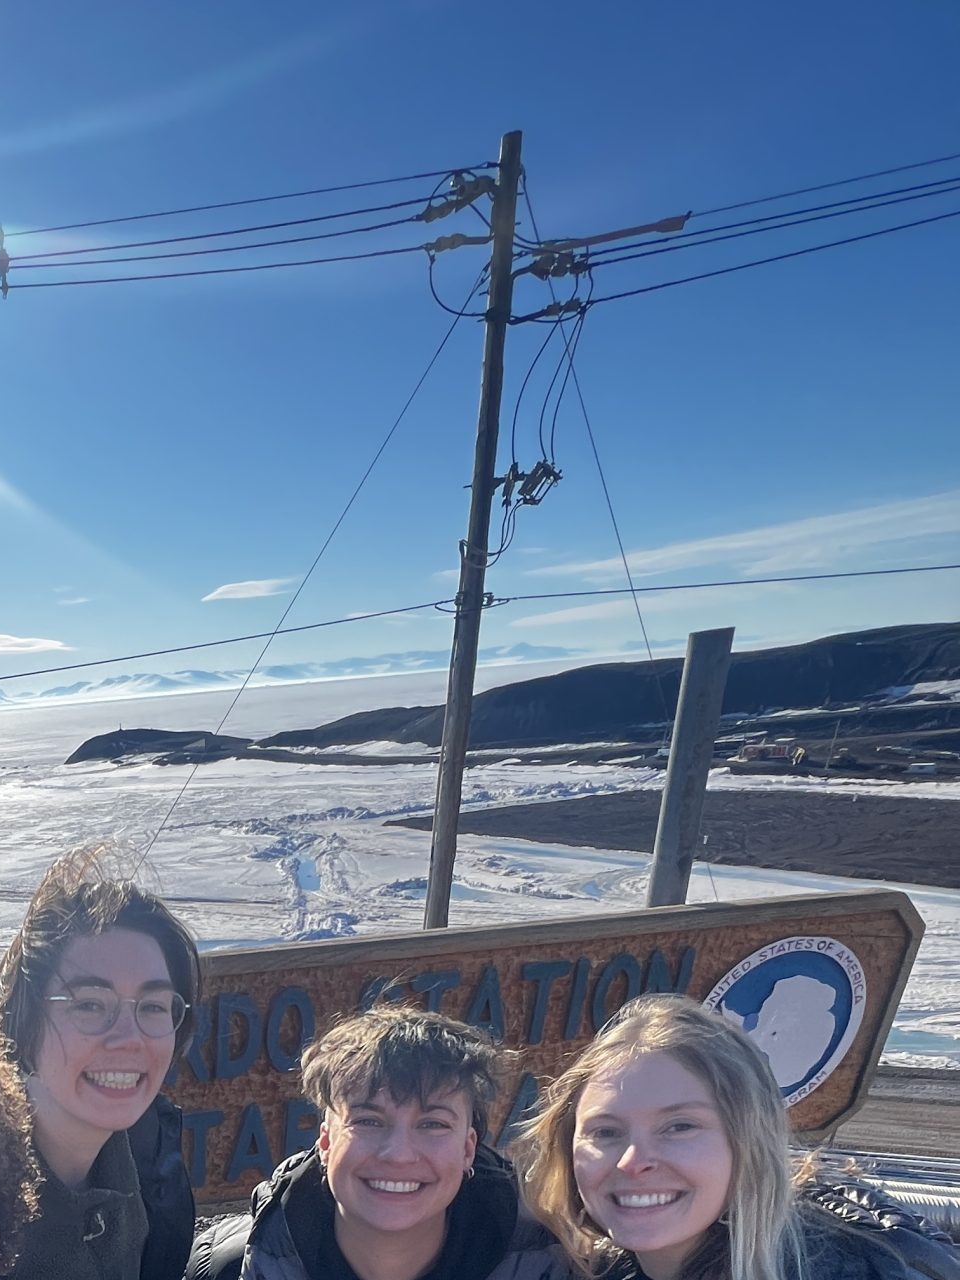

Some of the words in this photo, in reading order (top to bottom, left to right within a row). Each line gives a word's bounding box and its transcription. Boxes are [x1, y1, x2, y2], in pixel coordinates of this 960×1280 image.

[758, 938, 815, 962] STATES
[816, 940, 836, 952] OF
[836, 950, 865, 1005] AMERICA
[786, 1070, 827, 1105] GRAM
